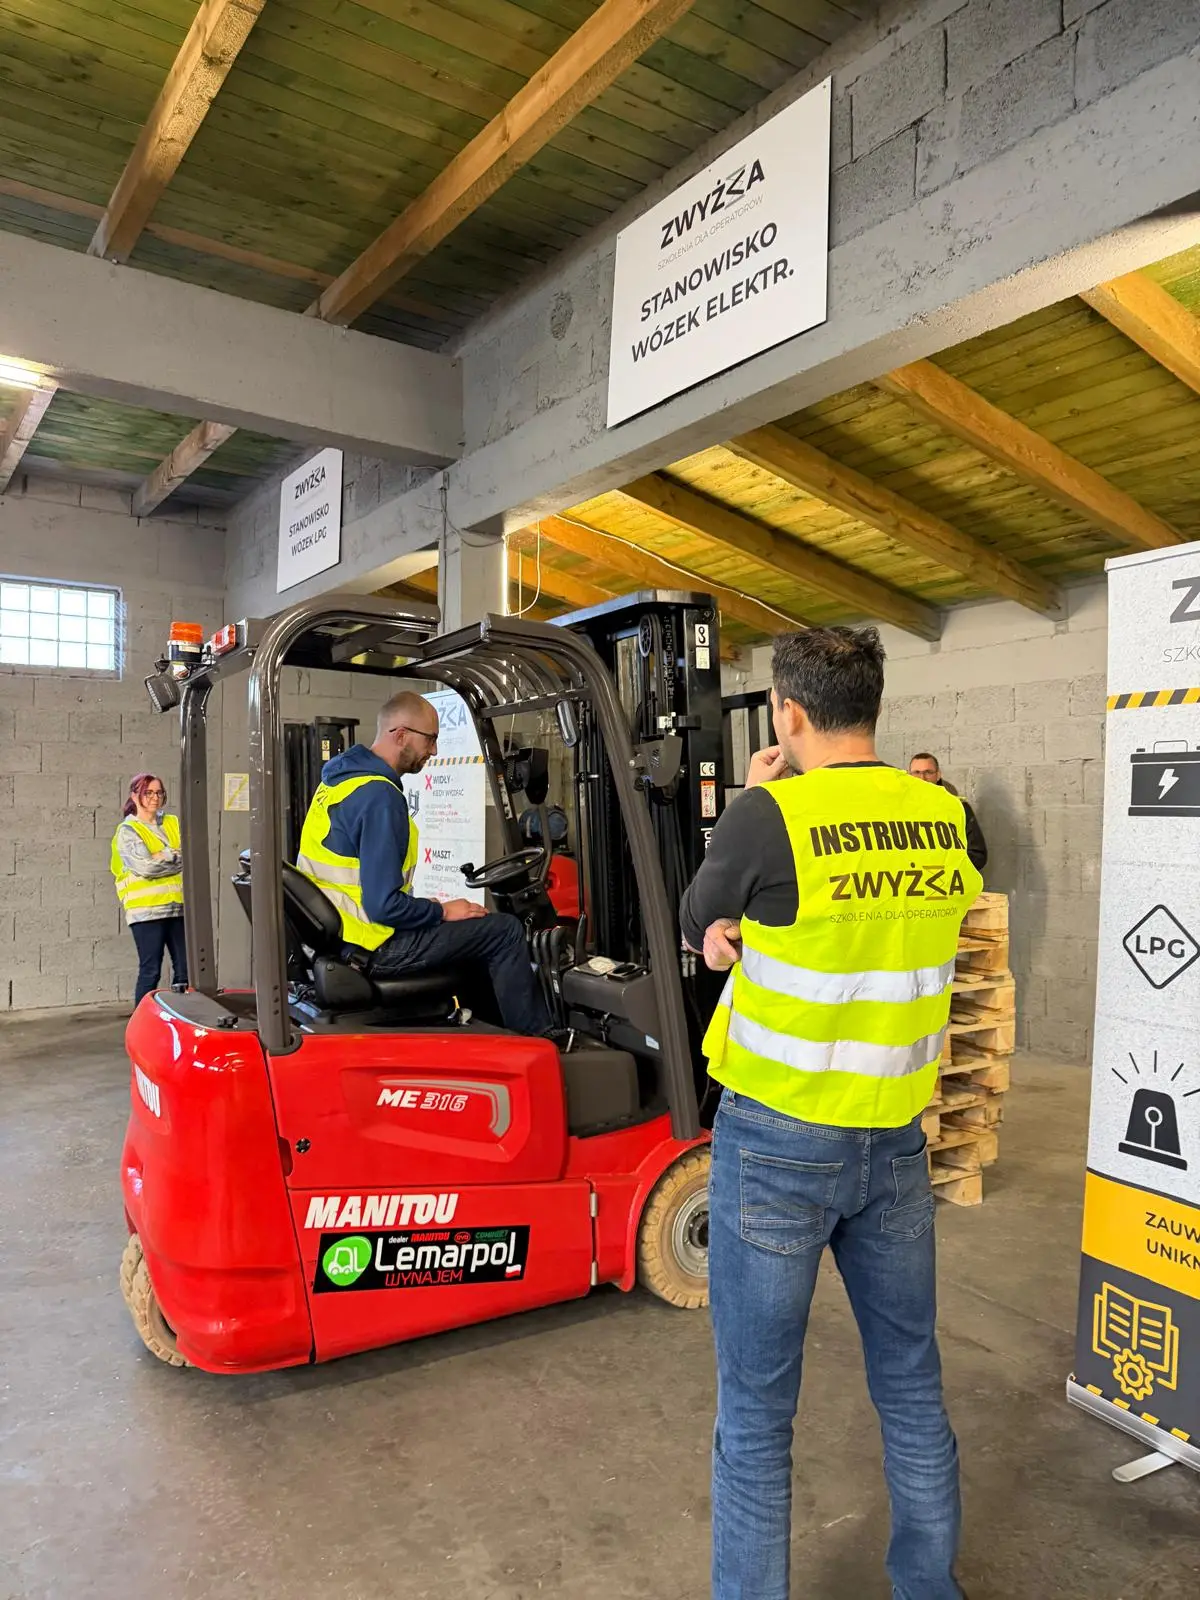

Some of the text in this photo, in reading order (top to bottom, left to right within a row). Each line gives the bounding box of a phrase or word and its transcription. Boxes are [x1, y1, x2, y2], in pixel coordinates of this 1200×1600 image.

[694, 230, 709, 246] DLA
[640, 221, 778, 322] STANOWISKO
[631, 257, 795, 363] WÓZEK ELEKTR.
[289, 503, 330, 538] STANOWISKO
[291, 526, 328, 557] WÓZEK LPG
[809, 820, 966, 858] INSTRUKTOR
[432, 850, 451, 860] MASZT
[830, 911, 883, 924] SZKOLENIA
[884, 909, 905, 920] DLA
[1134, 934, 1186, 960] LPG
[376, 1088, 469, 1112] ME 316
[303, 1192, 460, 1229] MANITOU
[388, 1235, 409, 1244] dealer
[410, 1231, 451, 1243] MANITOU
[374, 1231, 517, 1273] Lemarpol
[385, 1269, 464, 1287] WYNAJEM
